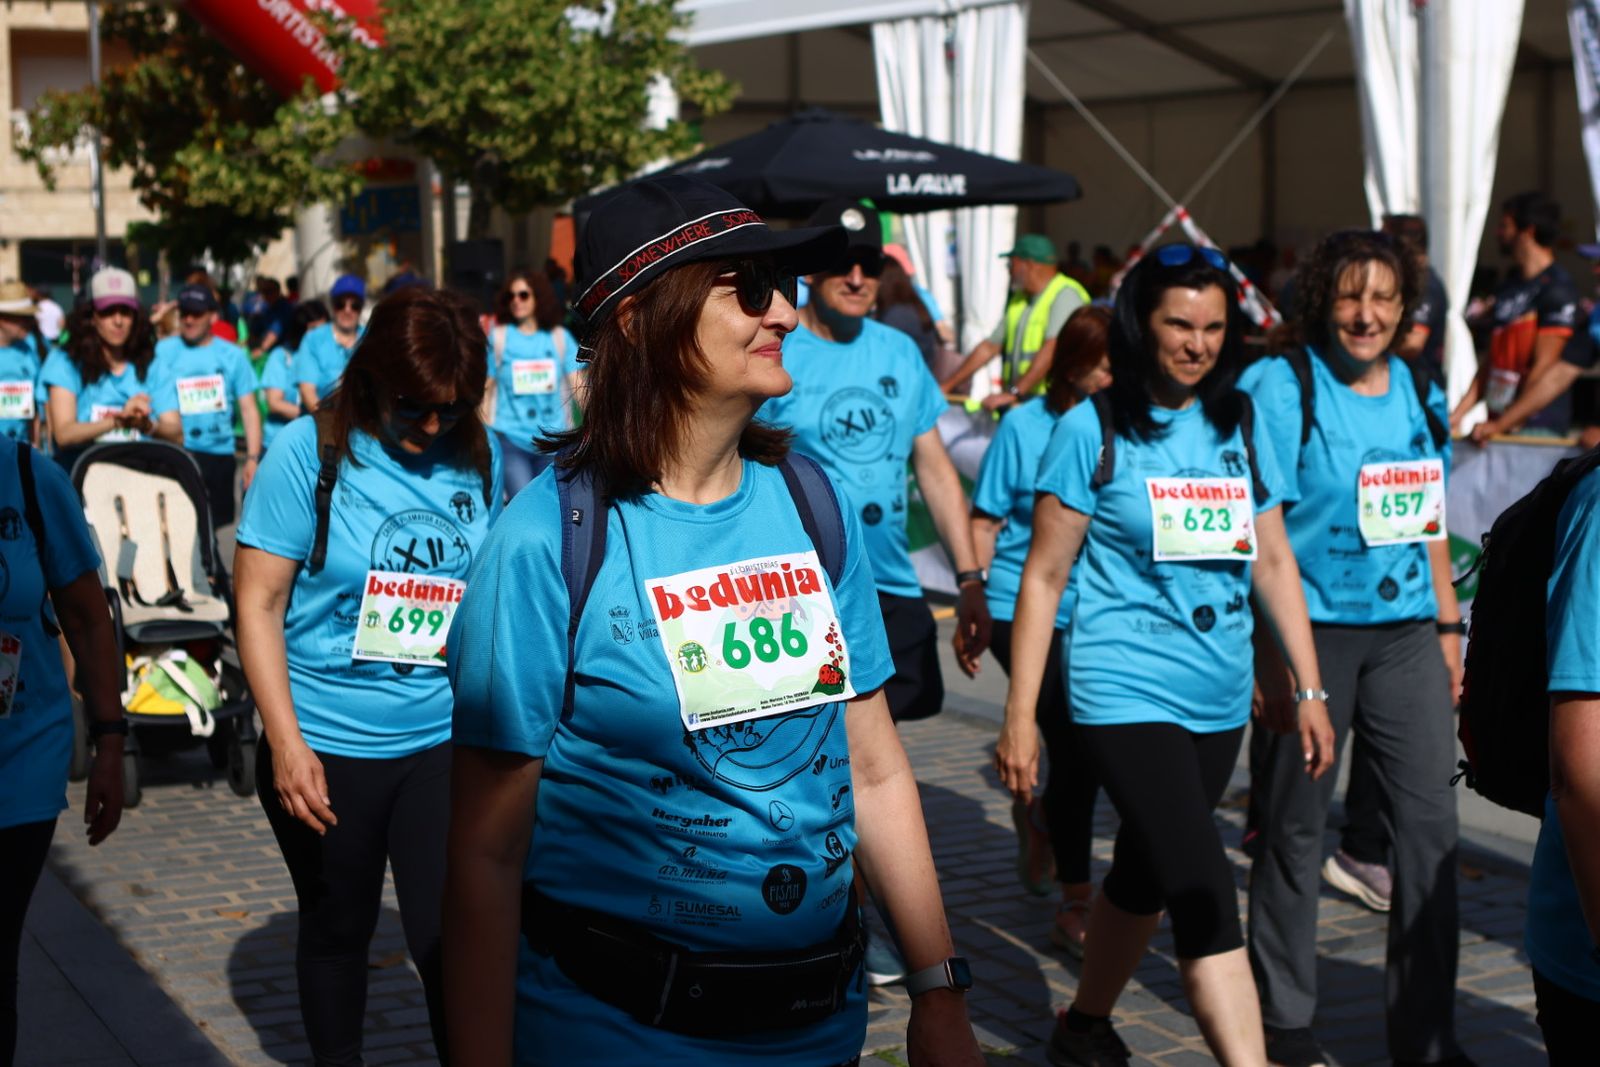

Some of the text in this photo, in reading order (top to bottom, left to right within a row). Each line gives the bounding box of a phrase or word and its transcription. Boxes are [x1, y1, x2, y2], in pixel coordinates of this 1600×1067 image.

[618, 221, 713, 283] SOMEWHERE
[1380, 492, 1424, 518] 657
[1183, 508, 1232, 532] 623
[652, 563, 821, 622] bedunia
[388, 606, 444, 636] 699
[722, 612, 808, 669] 686
[652, 807, 732, 828] Hergaher
[674, 901, 743, 917] SUMESAL
